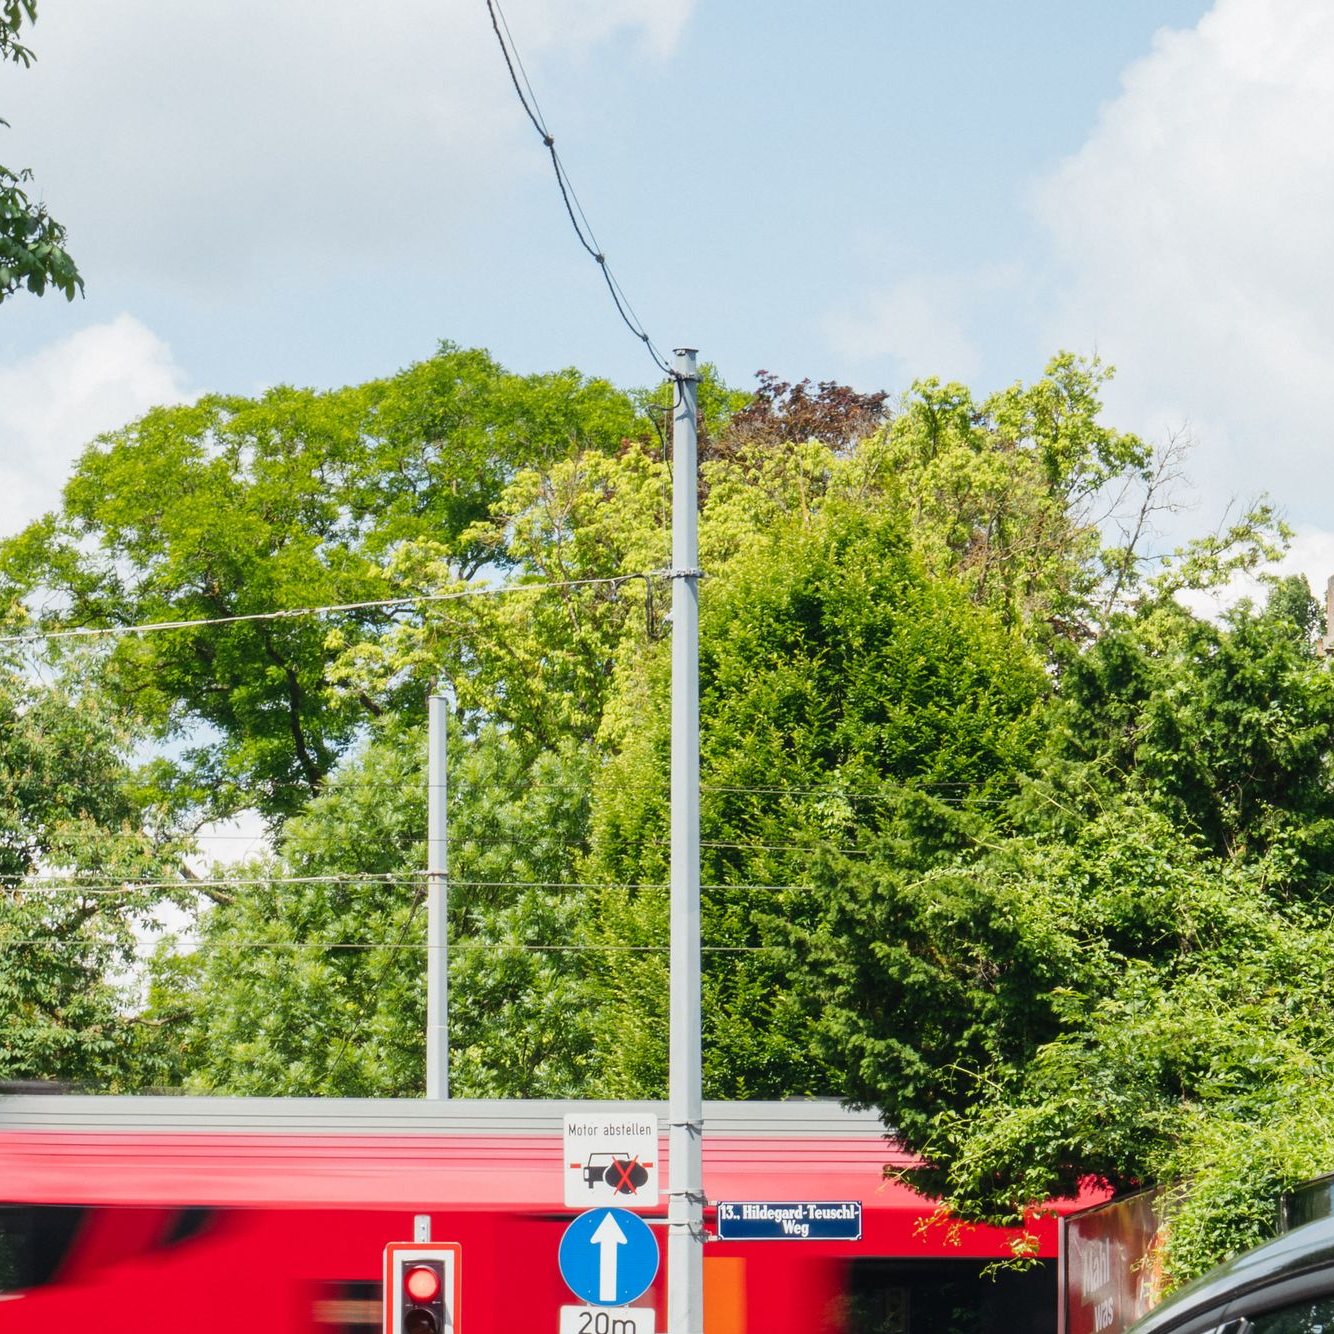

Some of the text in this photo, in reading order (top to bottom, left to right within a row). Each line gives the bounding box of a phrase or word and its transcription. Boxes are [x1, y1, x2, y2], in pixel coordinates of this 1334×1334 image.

[568, 1122, 652, 1136] Motor abstellen
[721, 1204, 860, 1223] 13., Hildegard-Teuschl-
[782, 1219, 810, 1238] Weg
[1094, 1297, 1114, 1333] was
